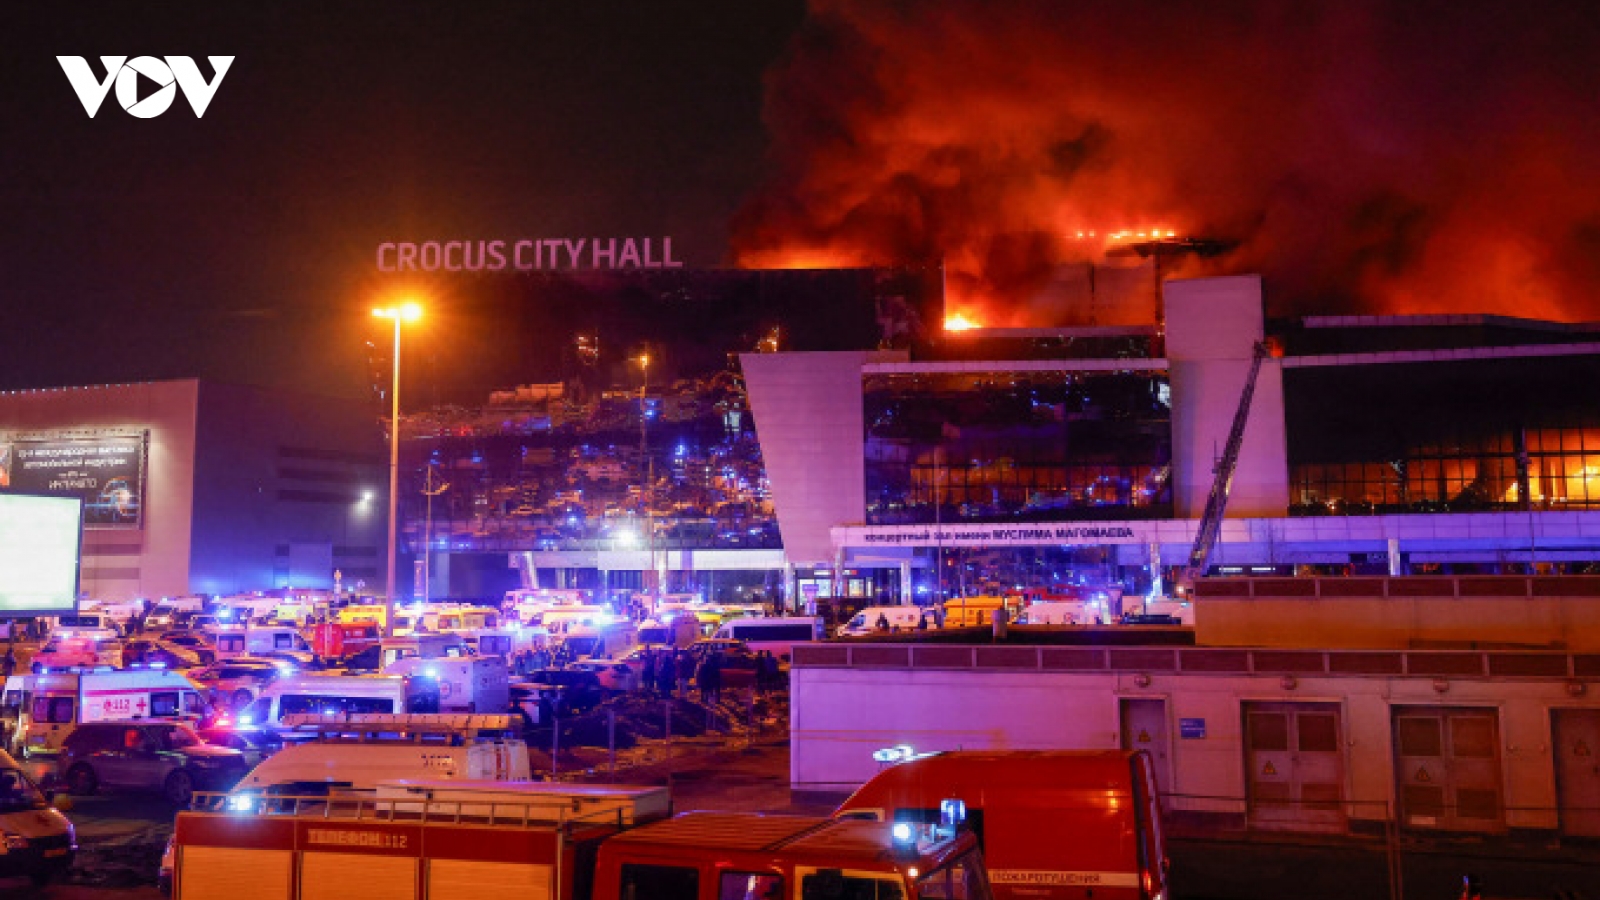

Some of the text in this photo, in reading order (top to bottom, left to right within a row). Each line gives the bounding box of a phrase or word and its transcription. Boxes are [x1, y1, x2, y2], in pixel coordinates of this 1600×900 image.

[376, 236, 683, 272] CROCUS CITY HALL
[992, 528, 1053, 540] МУСЛИМА
[1055, 526, 1135, 538] МАГОМАЕВА
[307, 828, 408, 848] ТЕЛЕФОН 112
